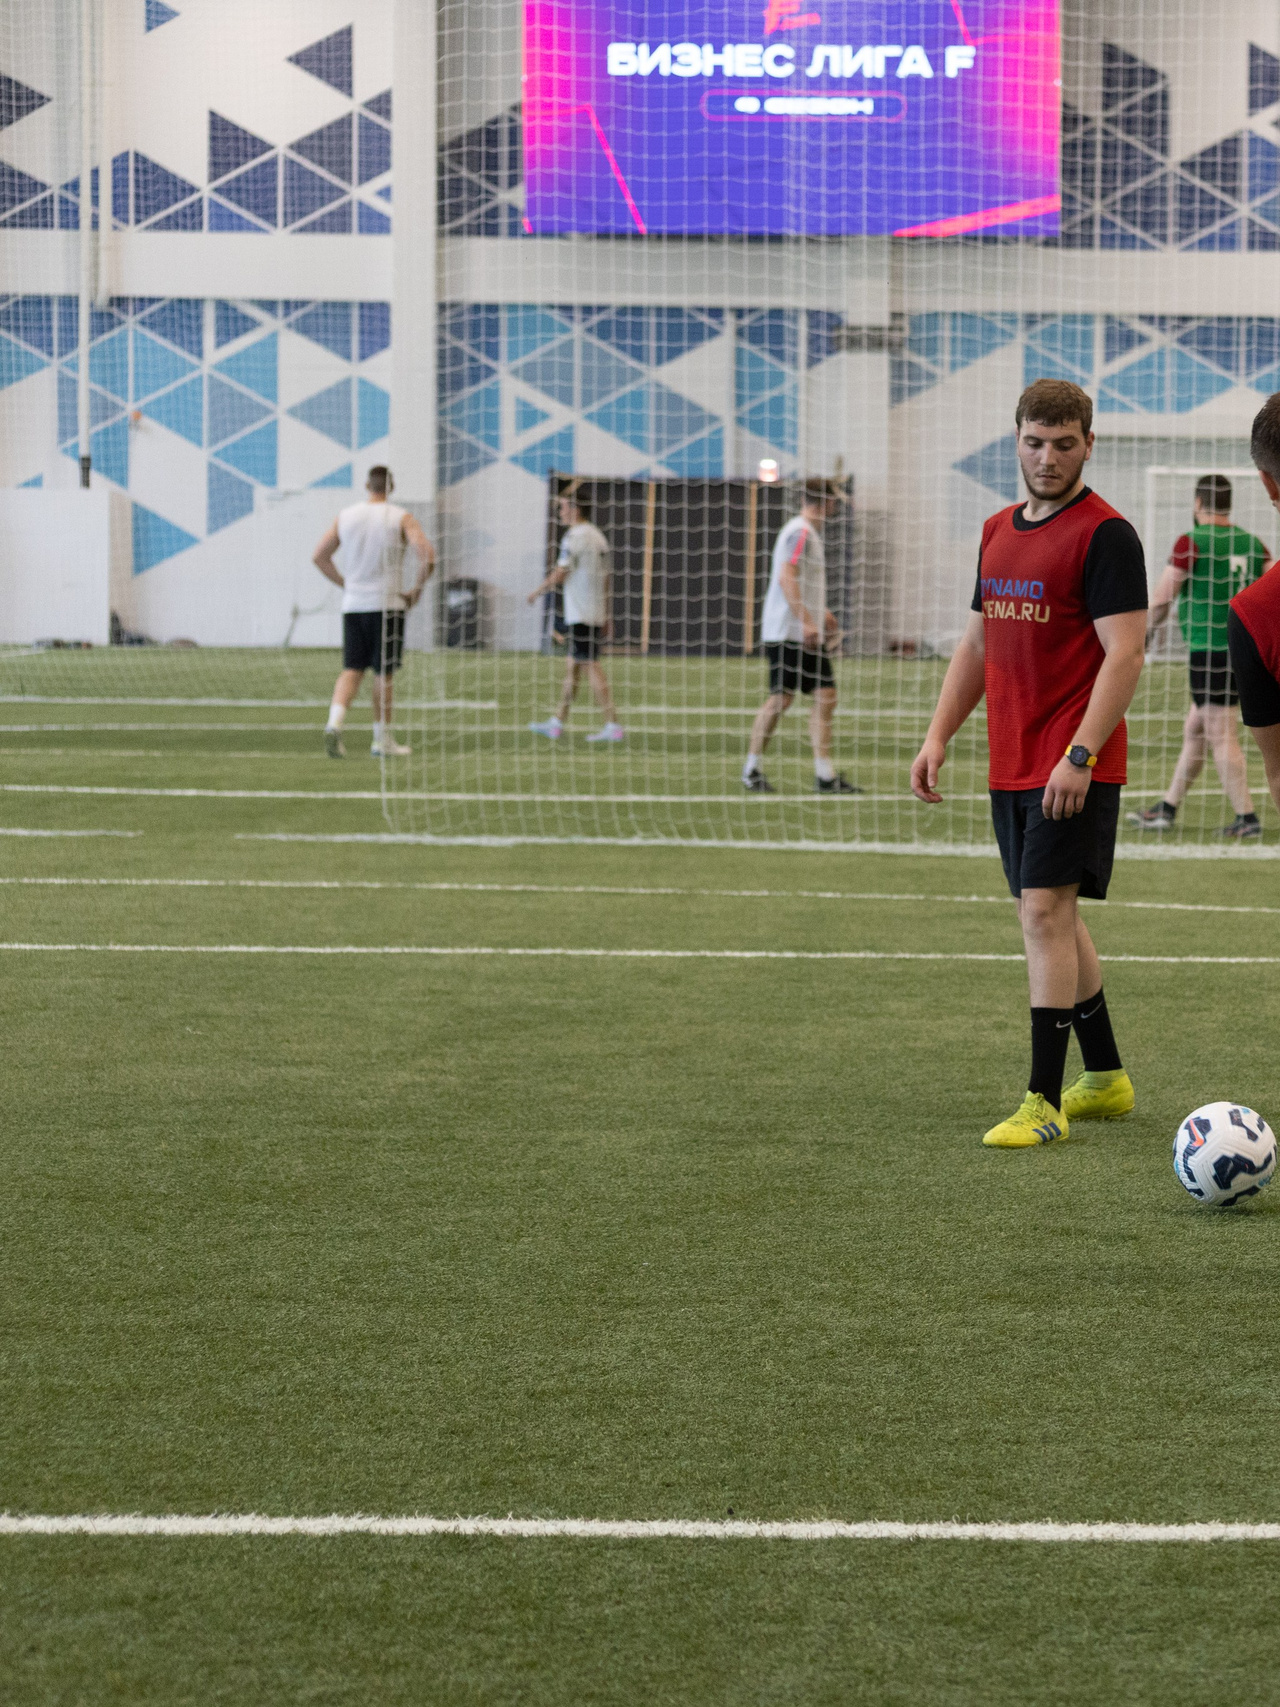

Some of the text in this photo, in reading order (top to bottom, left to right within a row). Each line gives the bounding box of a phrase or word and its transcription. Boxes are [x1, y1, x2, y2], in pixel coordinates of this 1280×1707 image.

[607, 42, 977, 78] БИЗНЕС ЛИГА F
